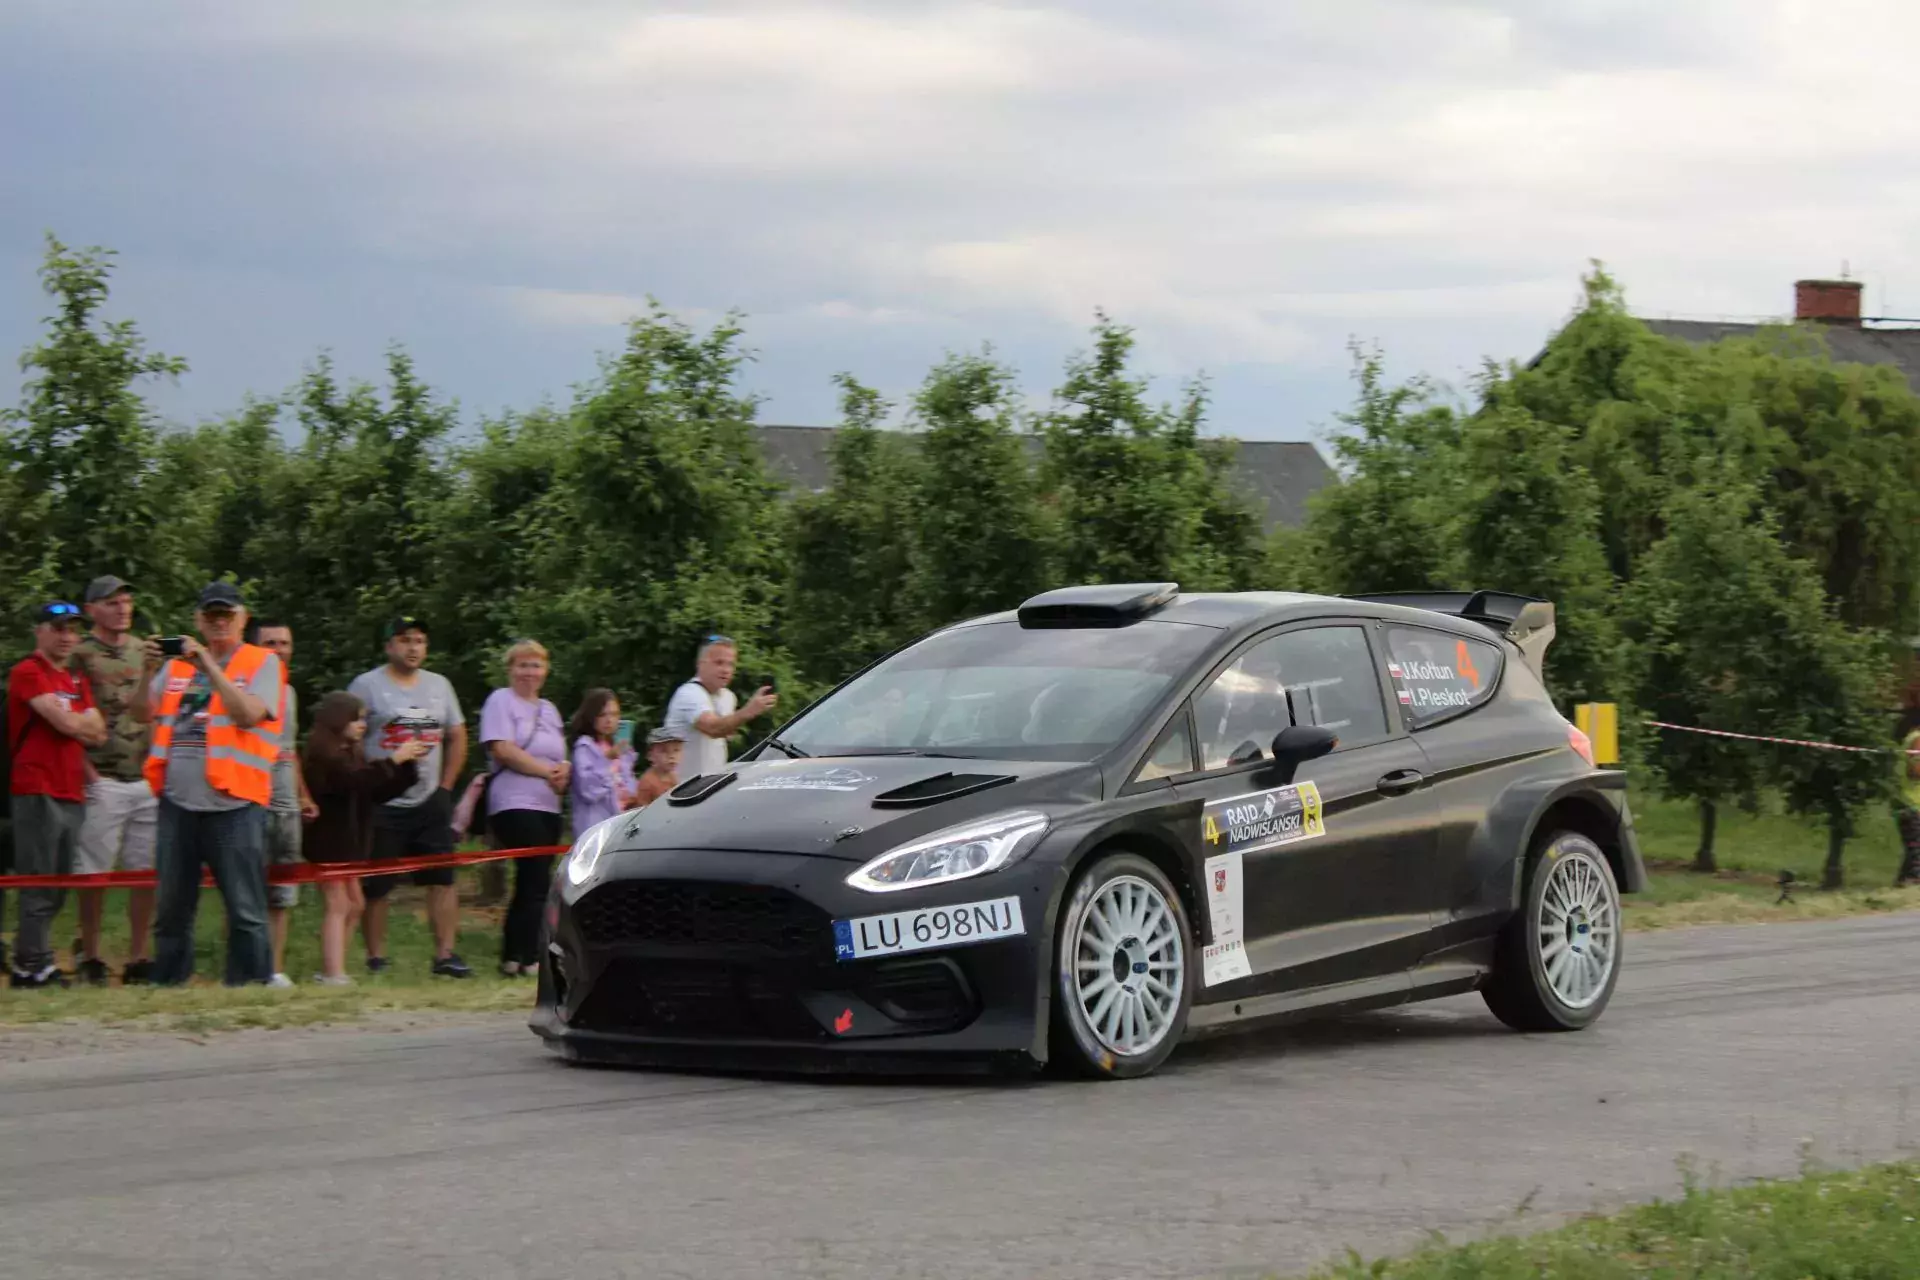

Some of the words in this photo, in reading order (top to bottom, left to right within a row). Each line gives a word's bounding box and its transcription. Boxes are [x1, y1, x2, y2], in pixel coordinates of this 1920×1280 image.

[1456, 640, 1479, 689] 4
[1410, 688, 1471, 707] I.Pleskot
[1226, 802, 1259, 826] RAJD
[1229, 814, 1300, 844] NADWIŚLAŃSKI
[1204, 815, 1220, 846] 4
[860, 917, 901, 951] LU
[912, 902, 1013, 943] 698NJ
[838, 944, 854, 955] PL
